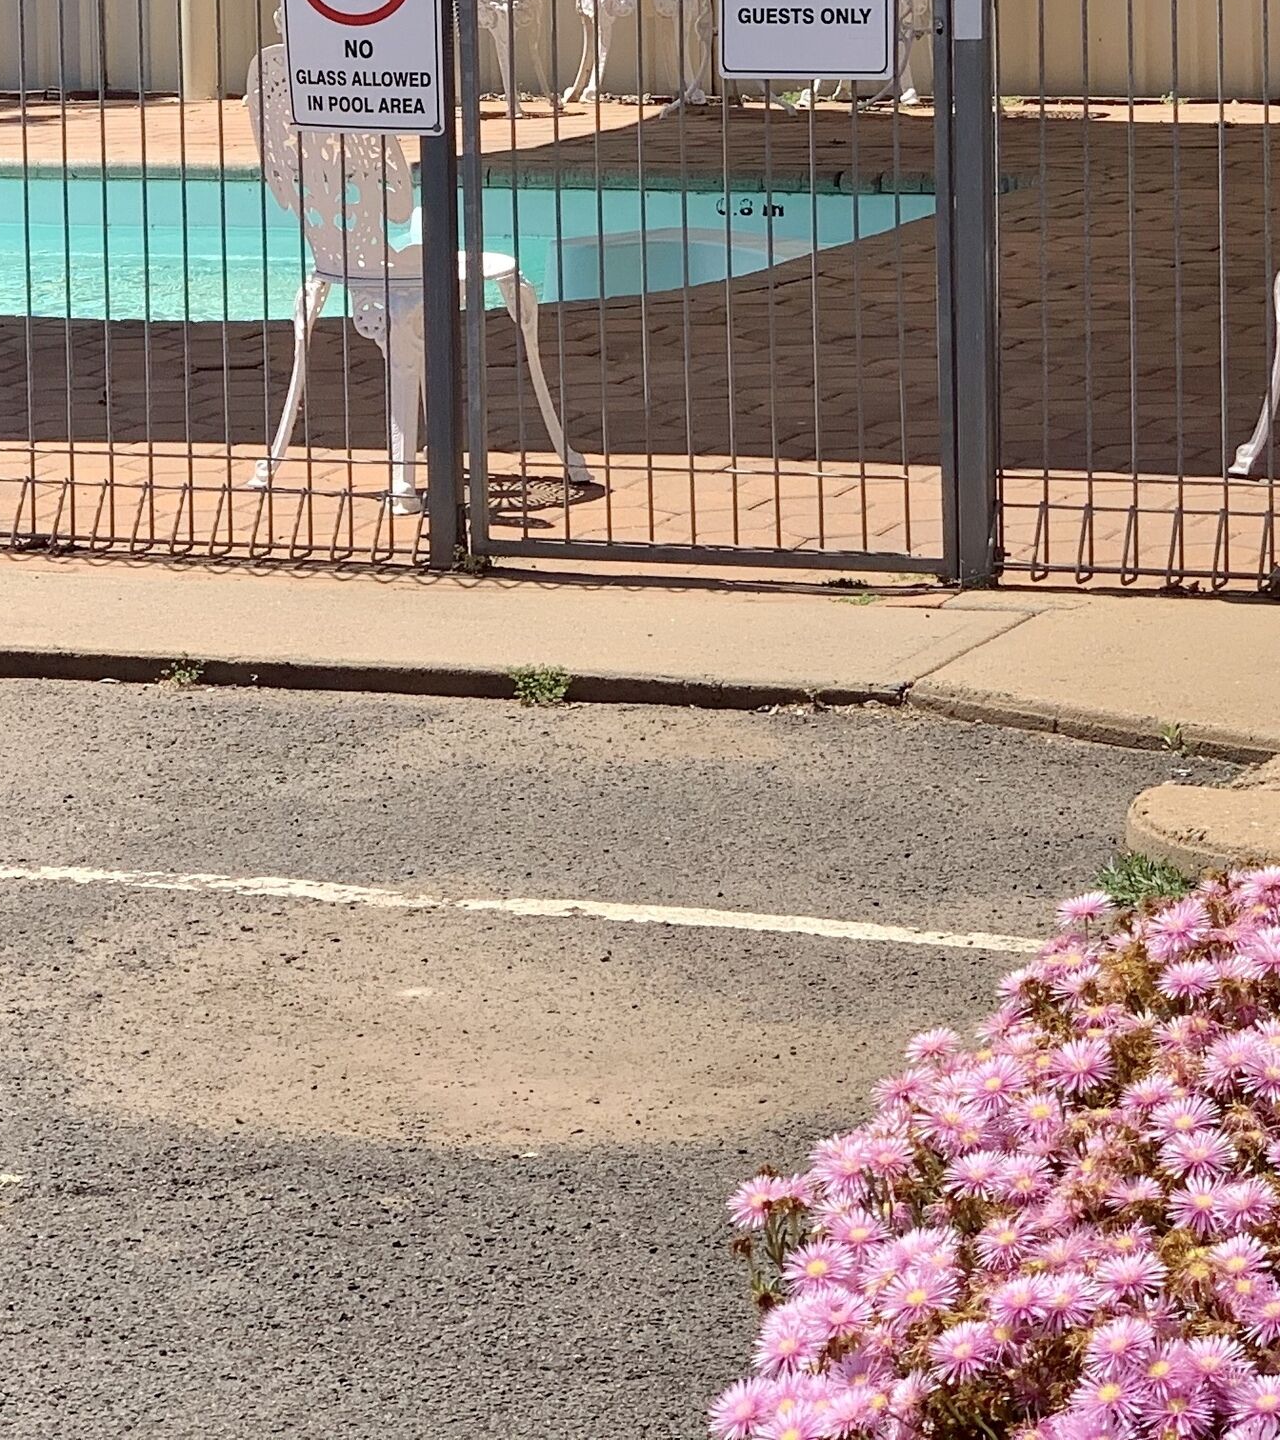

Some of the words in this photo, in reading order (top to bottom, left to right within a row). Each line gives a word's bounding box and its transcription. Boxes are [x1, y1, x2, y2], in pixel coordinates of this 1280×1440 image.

[737, 8, 815, 25] GUESTS
[820, 8, 872, 24] ONLY
[344, 39, 373, 59] NO
[296, 69, 347, 86] GLASS
[352, 71, 431, 88] ALLOWED
[307, 95, 323, 111] IN
[329, 96, 374, 113] POOL
[378, 98, 426, 114] AREA
